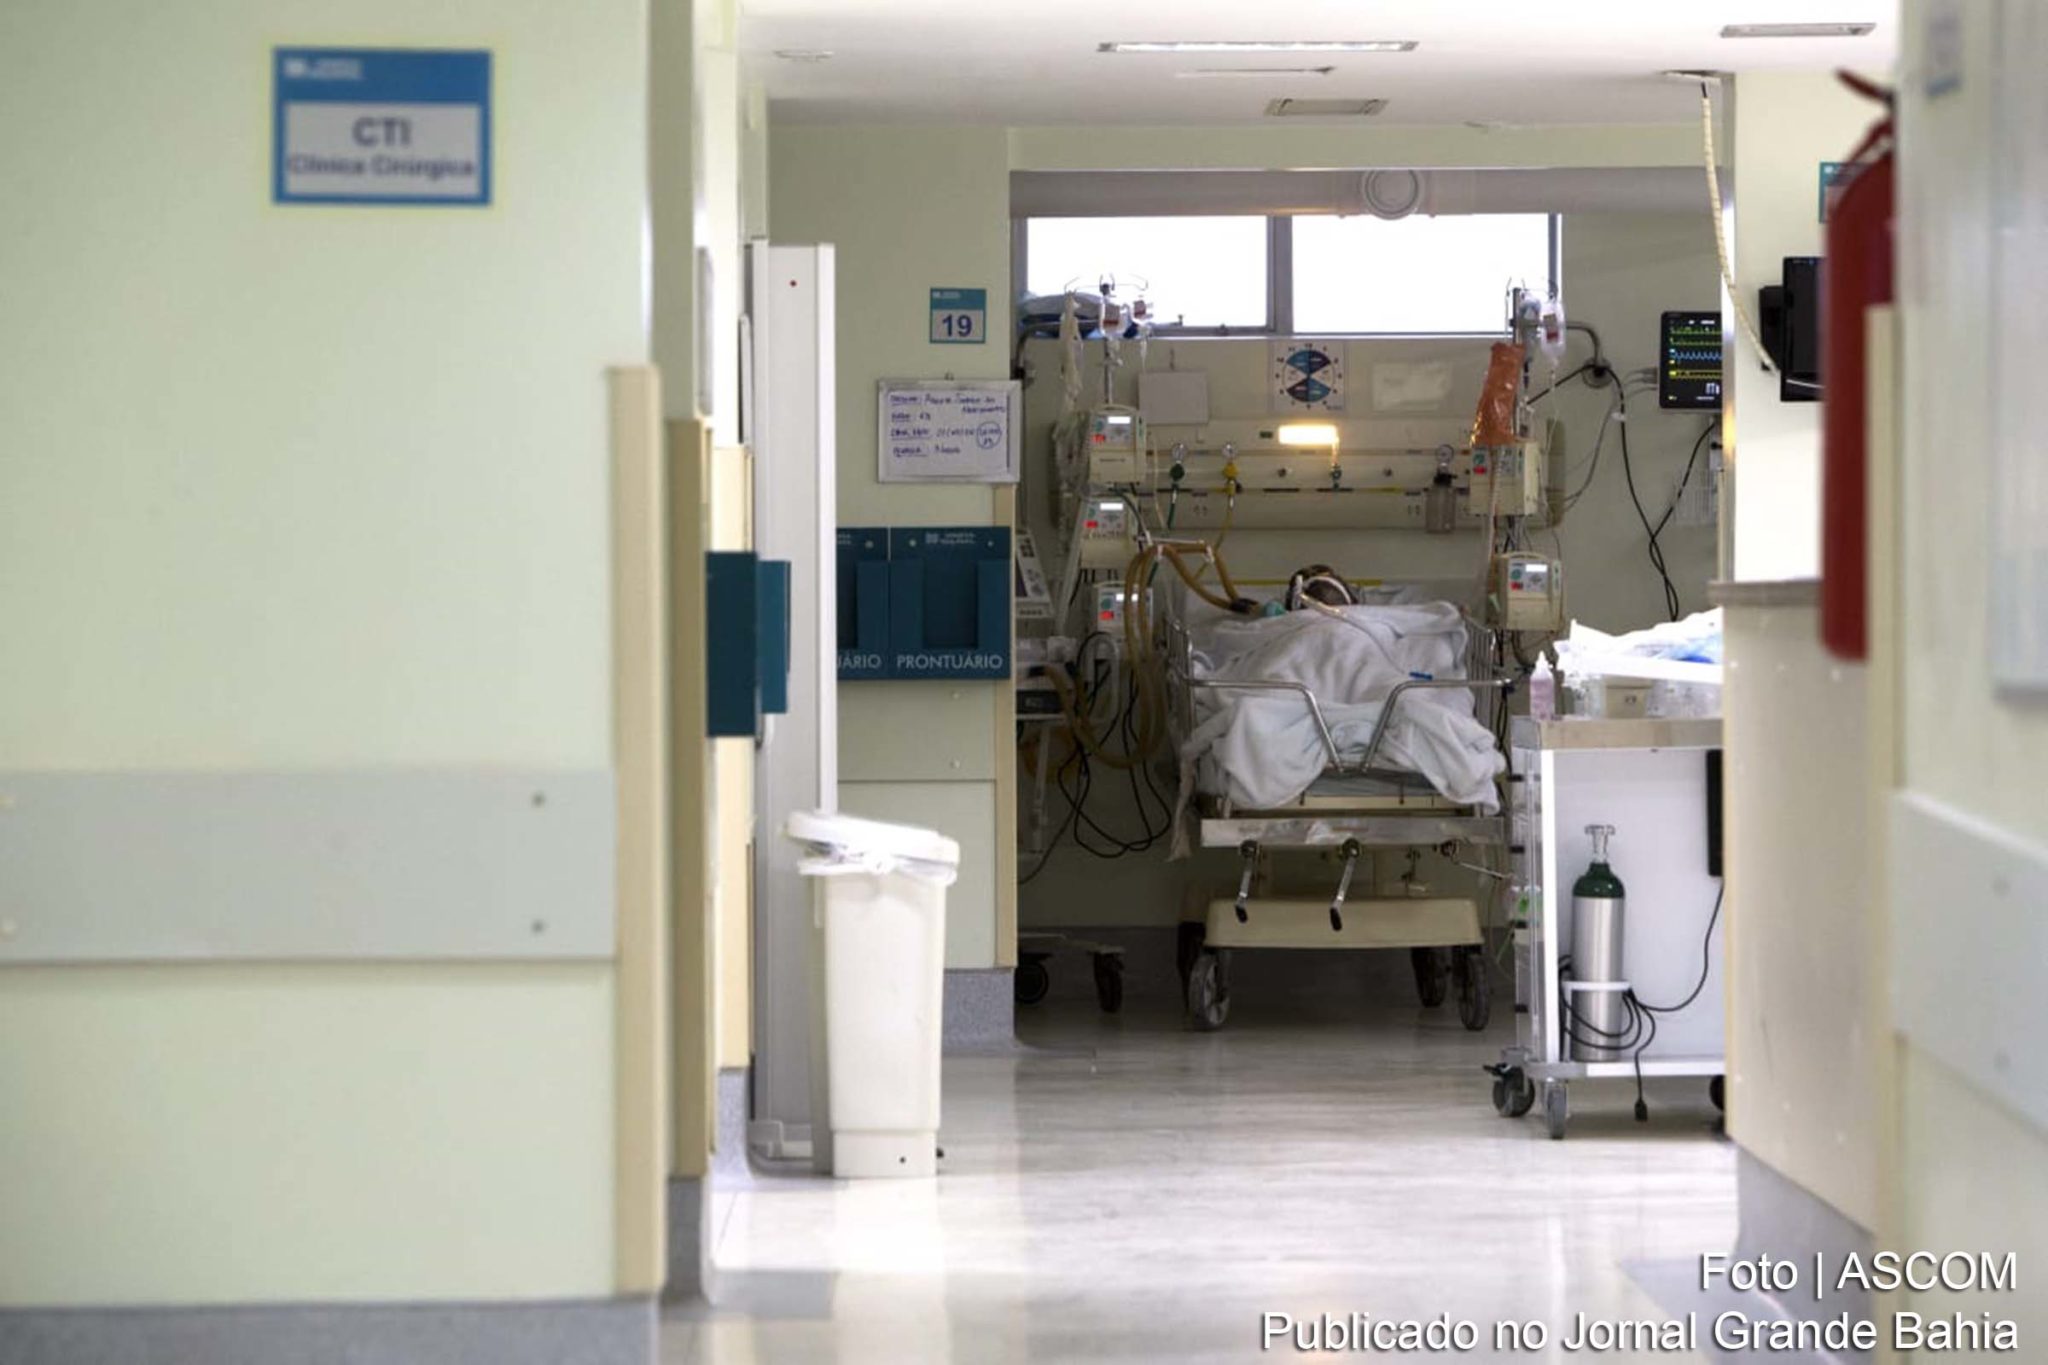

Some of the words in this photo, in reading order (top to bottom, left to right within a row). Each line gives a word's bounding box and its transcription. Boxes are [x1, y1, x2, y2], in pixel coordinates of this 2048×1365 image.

[352, 116, 412, 146] CTI
[942, 313, 972, 337] 19
[896, 651, 1003, 670] PRONTUÁRIO
